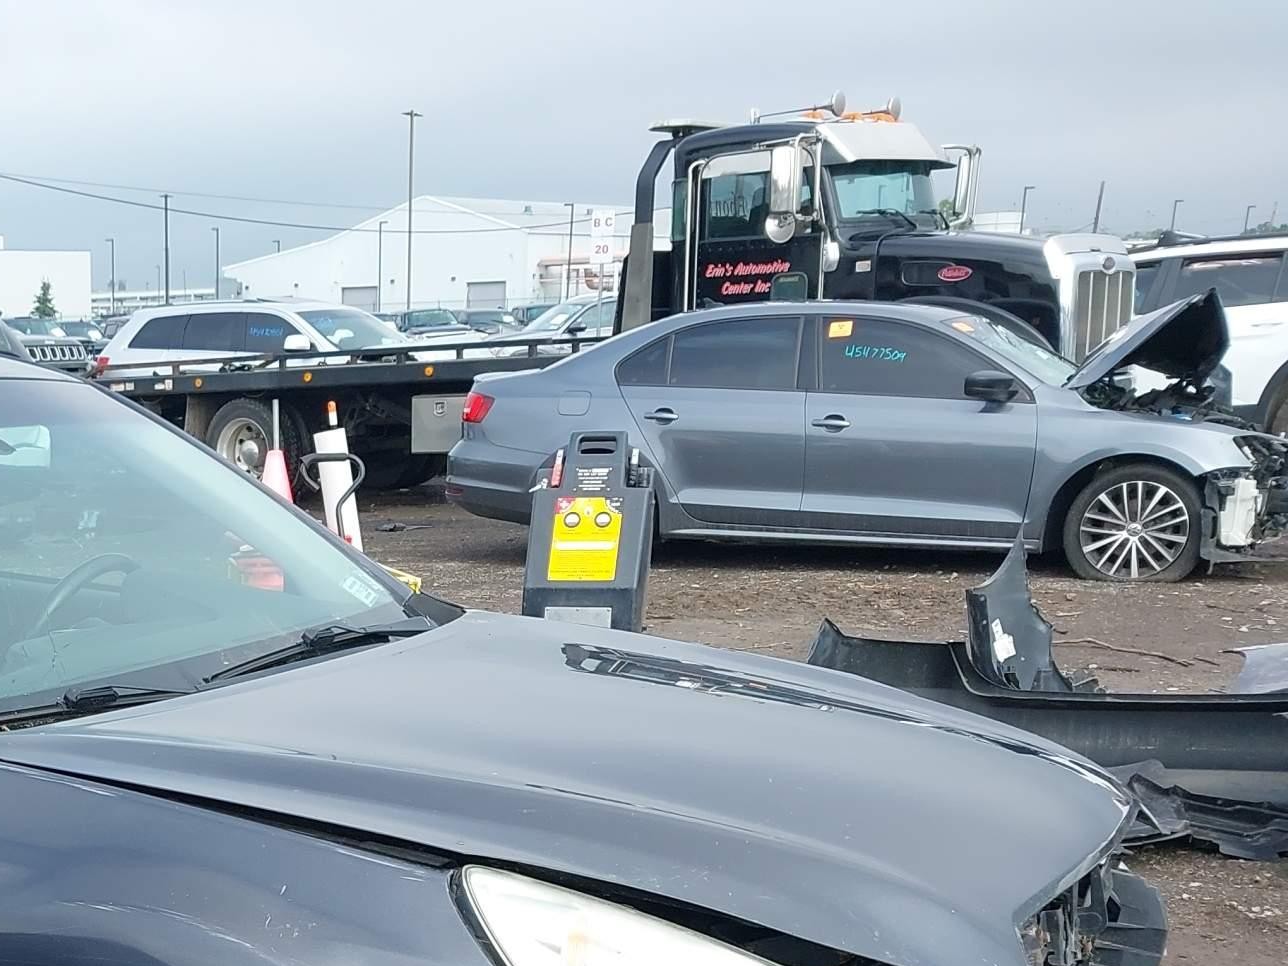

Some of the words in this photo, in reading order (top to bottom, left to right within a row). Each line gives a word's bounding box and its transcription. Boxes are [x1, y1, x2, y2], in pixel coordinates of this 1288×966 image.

[605, 217, 613, 227] C
[595, 244, 609, 254] 20
[705, 263, 733, 278] Erin's
[734, 259, 791, 276] Automotive
[721, 281, 753, 295] Center
[754, 279, 771, 293] Inc
